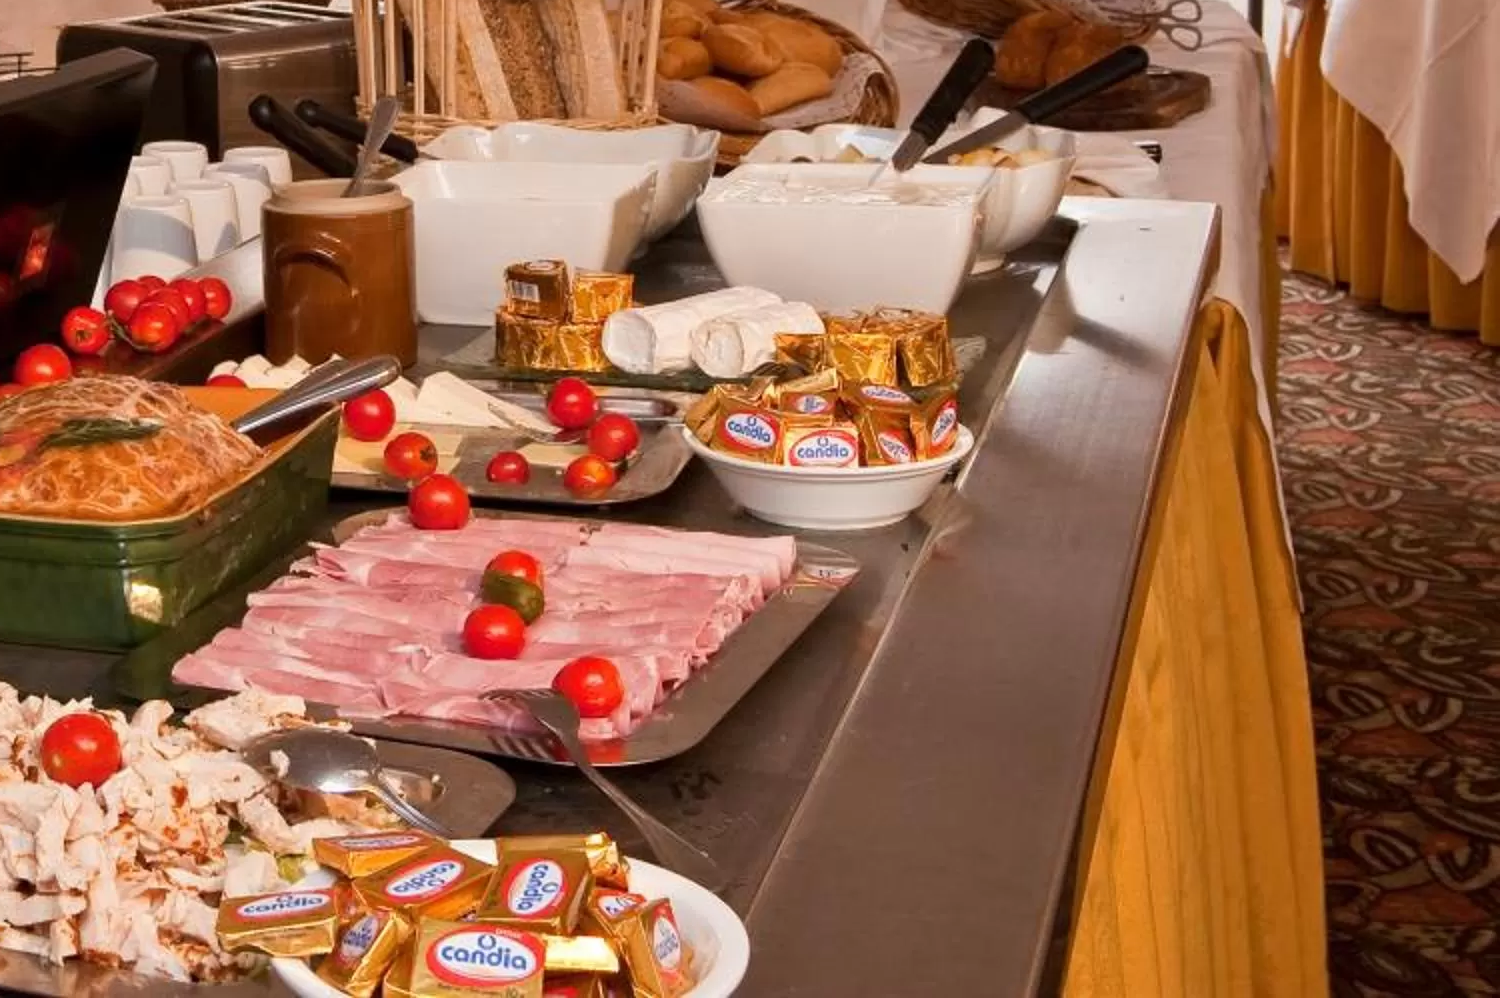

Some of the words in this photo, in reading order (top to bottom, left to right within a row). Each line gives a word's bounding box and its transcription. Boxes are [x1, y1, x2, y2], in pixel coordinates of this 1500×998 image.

[726, 419, 771, 444] candia
[797, 442, 849, 459] candia
[393, 862, 456, 893] candia
[517, 864, 549, 911] candia
[243, 895, 323, 914] candia
[440, 945, 527, 971] candia
